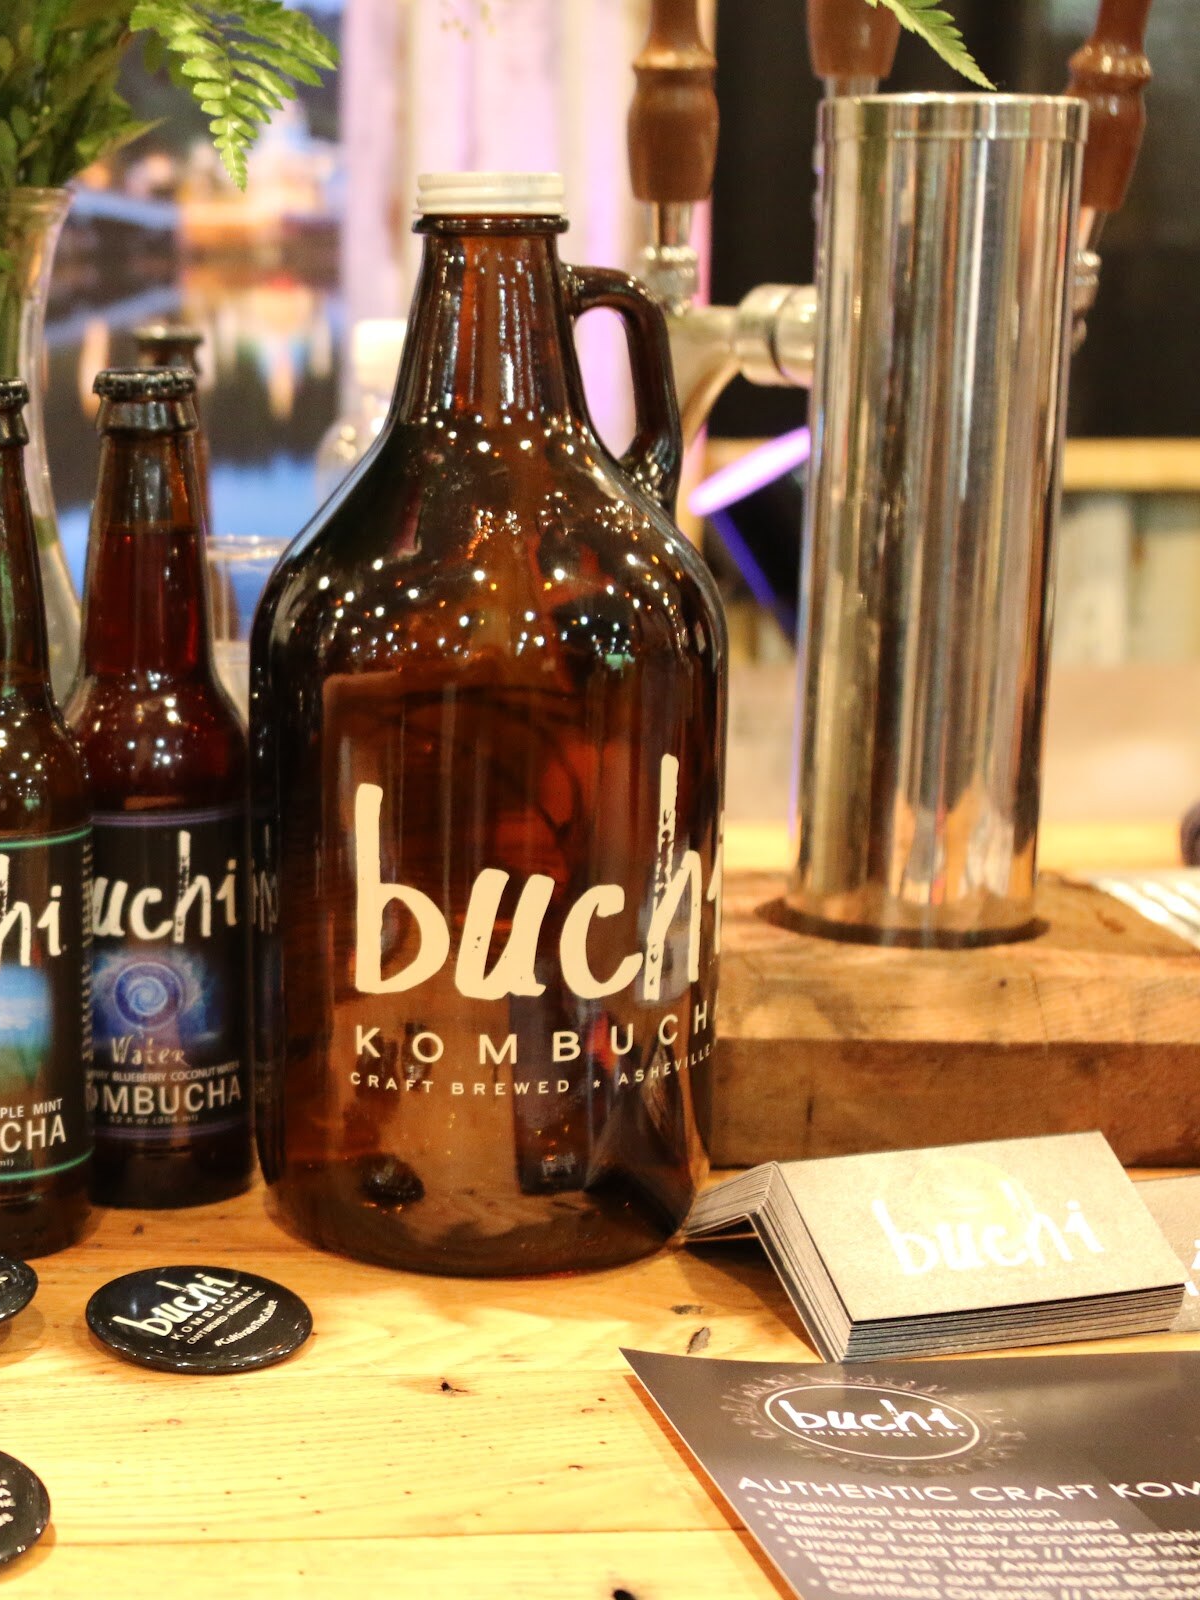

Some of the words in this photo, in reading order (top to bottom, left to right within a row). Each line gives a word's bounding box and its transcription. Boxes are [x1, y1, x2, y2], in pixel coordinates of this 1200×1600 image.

[170, 1066, 216, 1082] COCONUT
[350, 1071, 434, 1094] CRAFT
[452, 1079, 571, 1096] BREWED
[32, 1097, 64, 1116] MINT
[871, 1180, 1105, 1276] buchi
[112, 1273, 238, 1337] buchi
[171, 1285, 252, 1341] KOMBUCHA
[778, 1399, 960, 1432] buchi
[803, 1429, 870, 1437] THIRST
[738, 1477, 958, 1502] AUTHENTIC
[969, 1484, 1098, 1501] CRAFT
[762, 1498, 892, 1517] Traditional
[773, 1511, 884, 1528] Premium
[889, 1520, 941, 1531] and
[945, 1518, 1119, 1532] unpasteurized
[783, 1524, 866, 1541] Billions
[870, 1530, 896, 1542] of
[902, 1529, 1008, 1547] naturally
